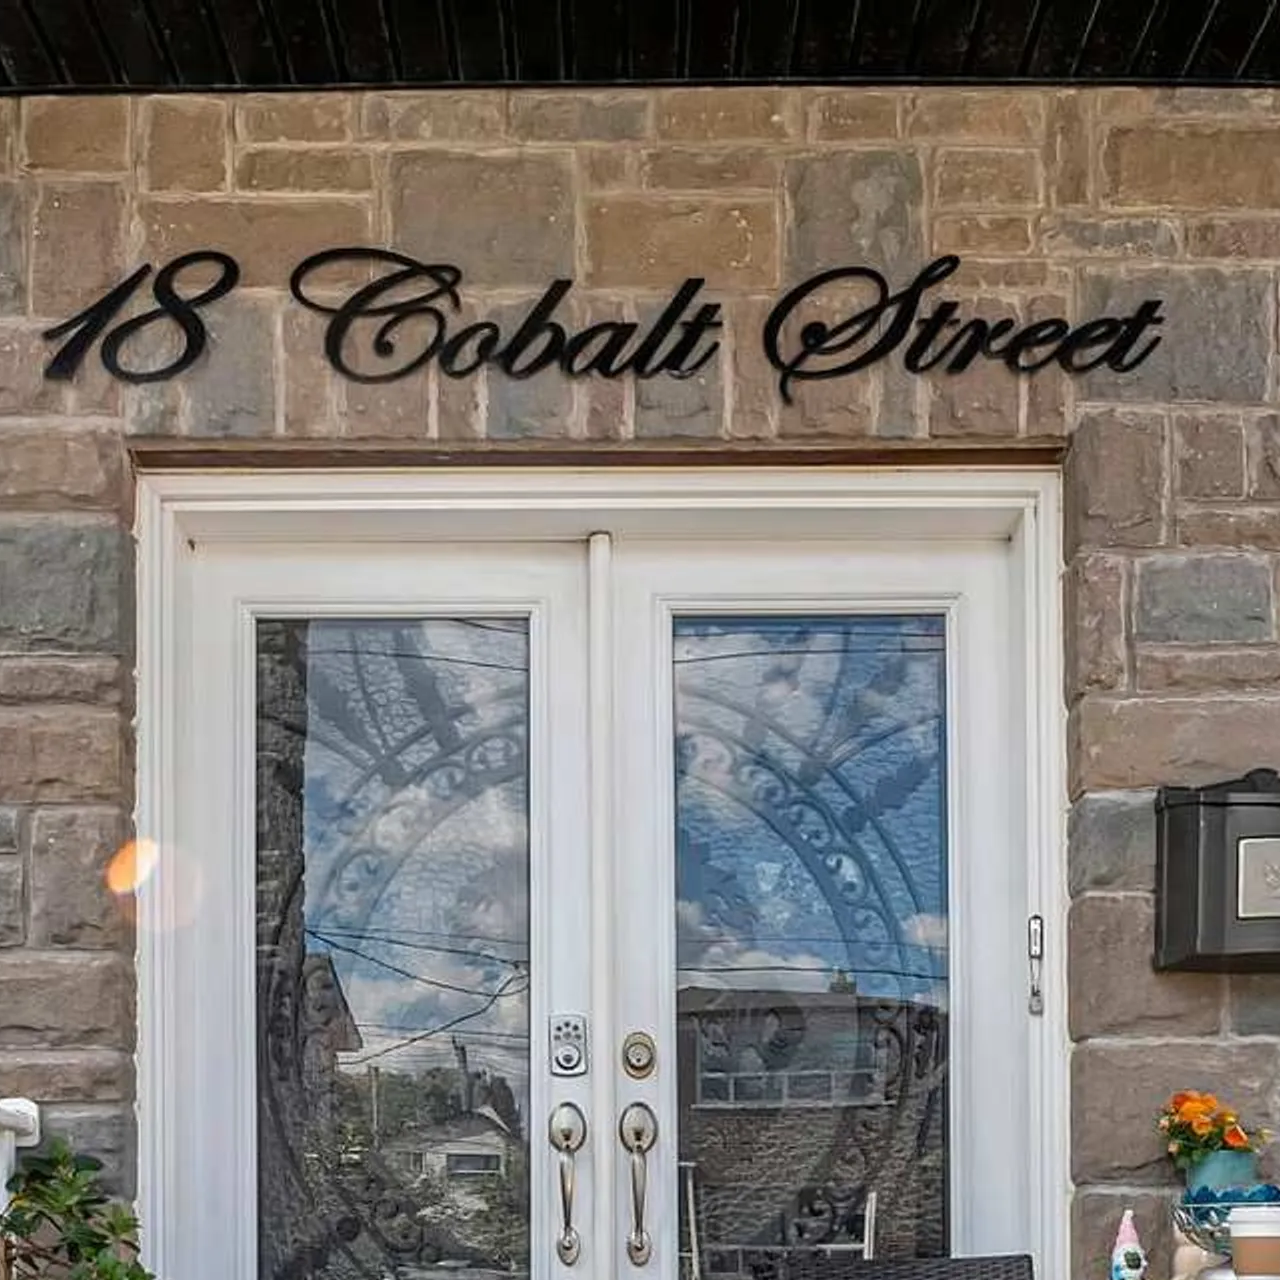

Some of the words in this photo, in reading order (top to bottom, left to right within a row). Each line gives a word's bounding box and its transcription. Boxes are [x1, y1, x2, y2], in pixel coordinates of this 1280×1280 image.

[43, 250, 240, 383] 18
[290, 247, 722, 383] Cobalt
[763, 254, 1164, 404] Street
